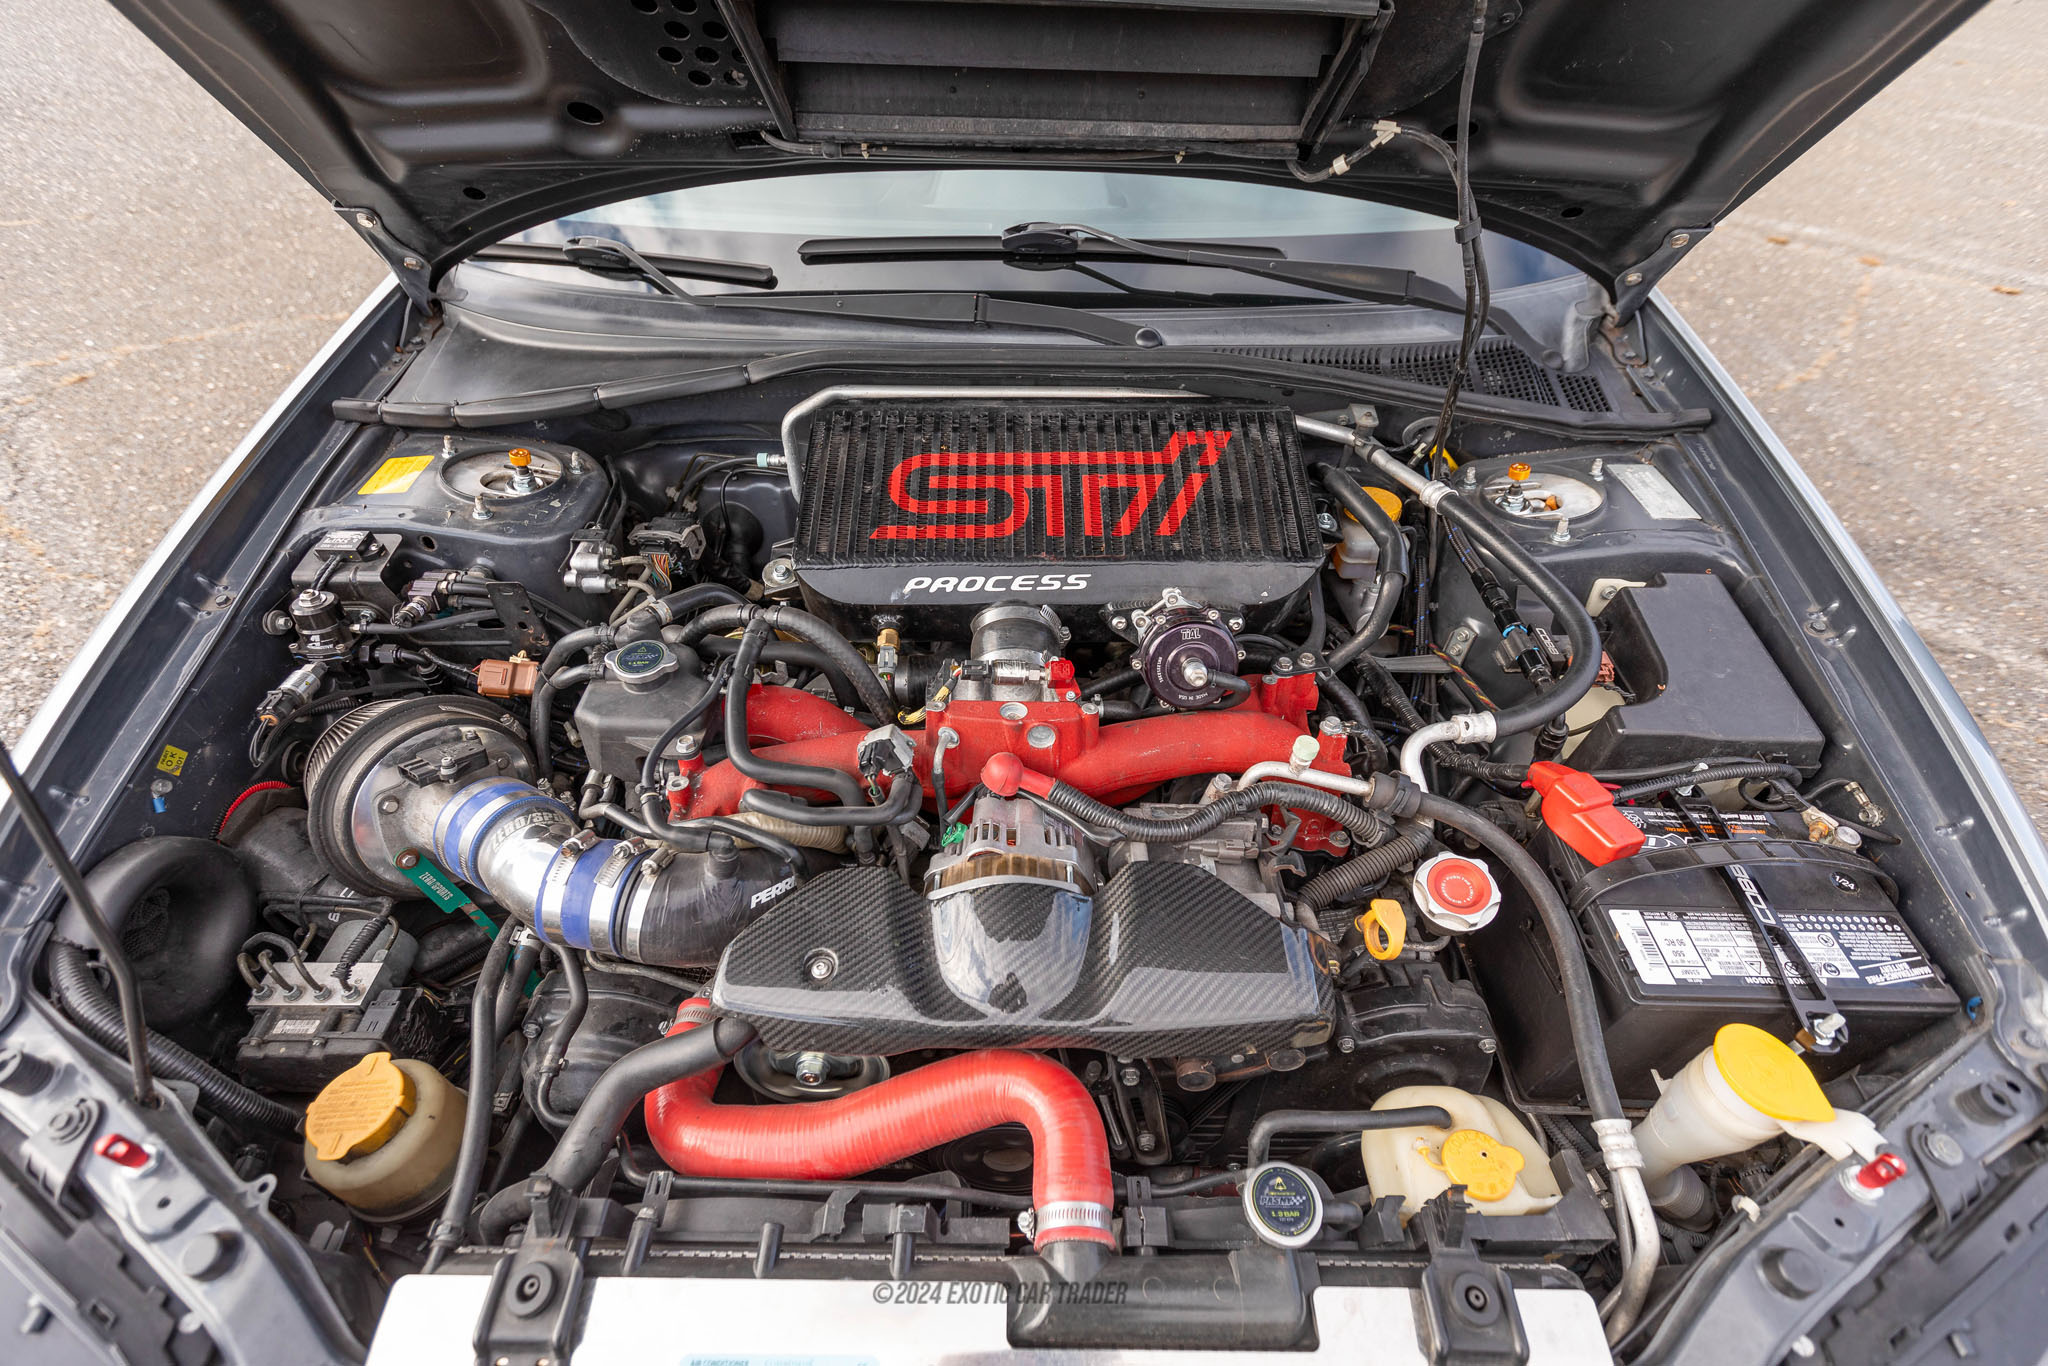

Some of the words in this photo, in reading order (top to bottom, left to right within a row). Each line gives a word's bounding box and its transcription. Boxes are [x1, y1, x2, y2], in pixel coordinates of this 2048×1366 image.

[903, 573, 1092, 594] PROCESS
[1536, 627, 1559, 655] COBB
[1729, 863, 1776, 924] COBB
[1864, 966, 1933, 985] MAINTENANCE-FREE
[1879, 962, 1909, 974] BATTERY
